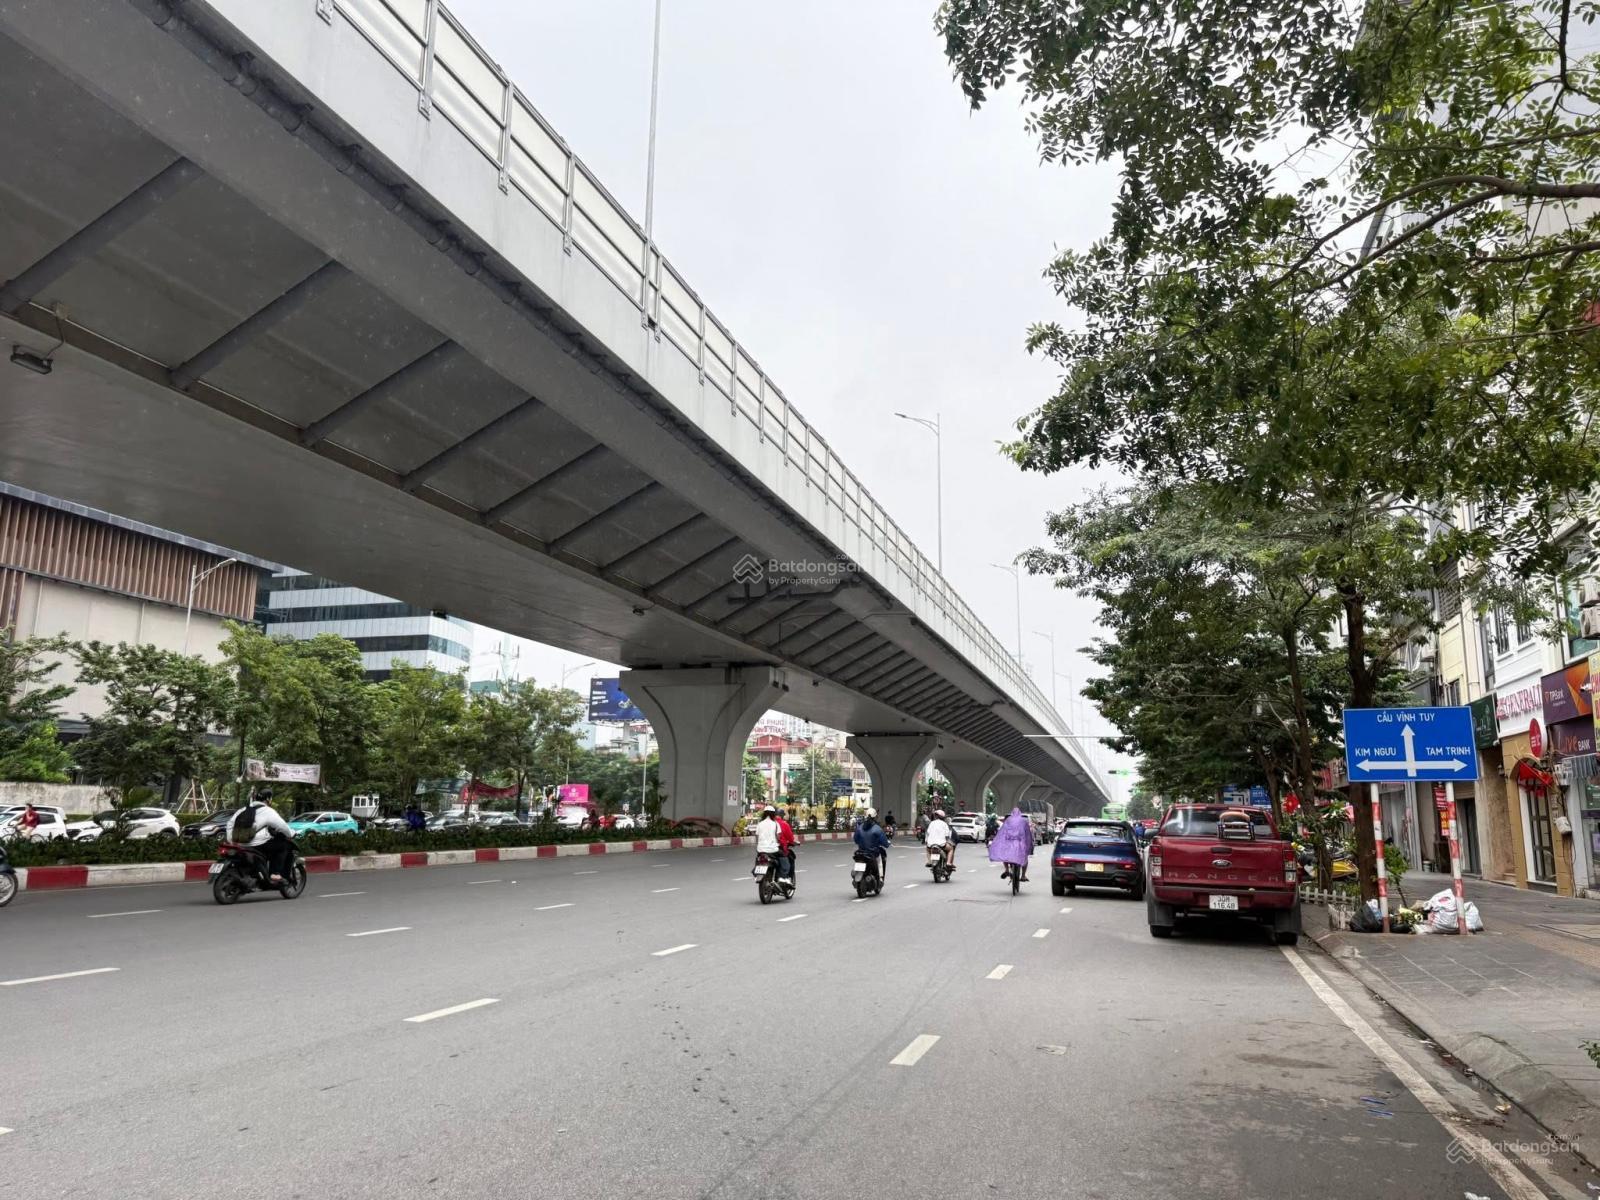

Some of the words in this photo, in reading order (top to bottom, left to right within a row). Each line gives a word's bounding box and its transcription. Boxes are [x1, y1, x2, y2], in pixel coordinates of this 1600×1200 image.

[1418, 713, 1435, 722] TUY
[1577, 738, 1591, 751] BANK
[1355, 747, 1371, 757] KIM
[1425, 746, 1444, 756] TAM
[1444, 746, 1471, 756] TRINH
